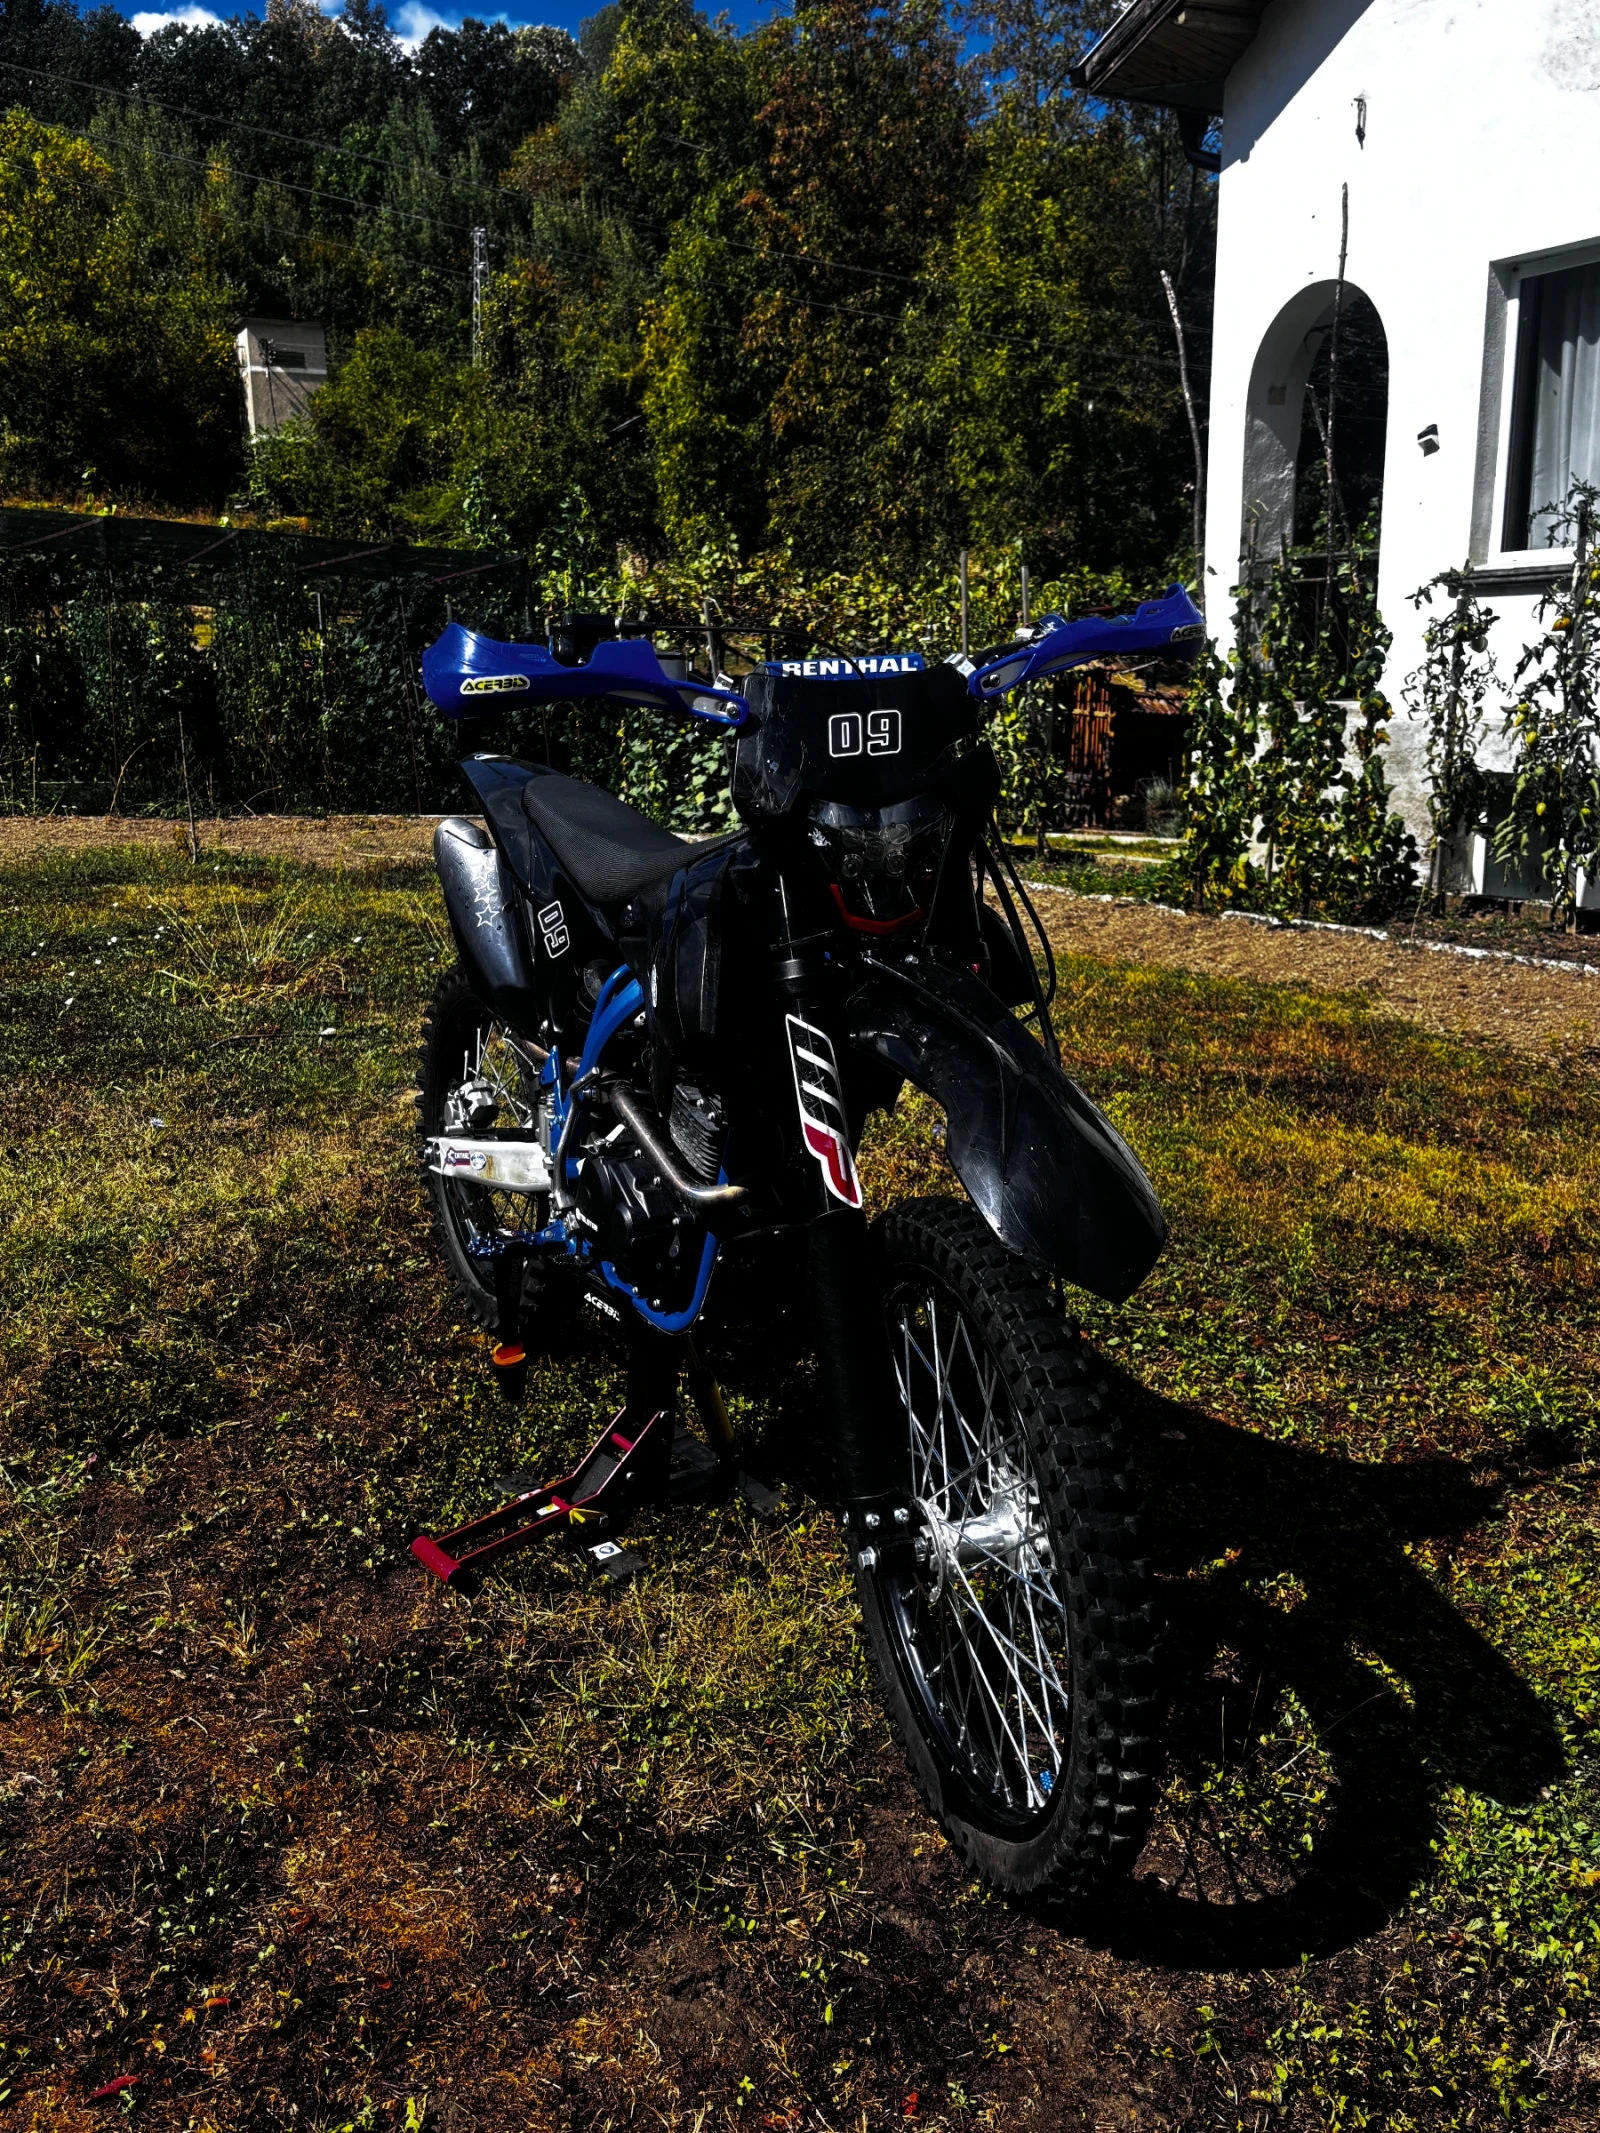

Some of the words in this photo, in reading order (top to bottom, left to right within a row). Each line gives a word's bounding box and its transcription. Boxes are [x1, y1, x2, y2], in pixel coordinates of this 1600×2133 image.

[463, 677, 528, 692] ACERBIS
[781, 657, 918, 678] RENTHAL
[828, 708, 902, 758] 09
[537, 900, 571, 960] 09
